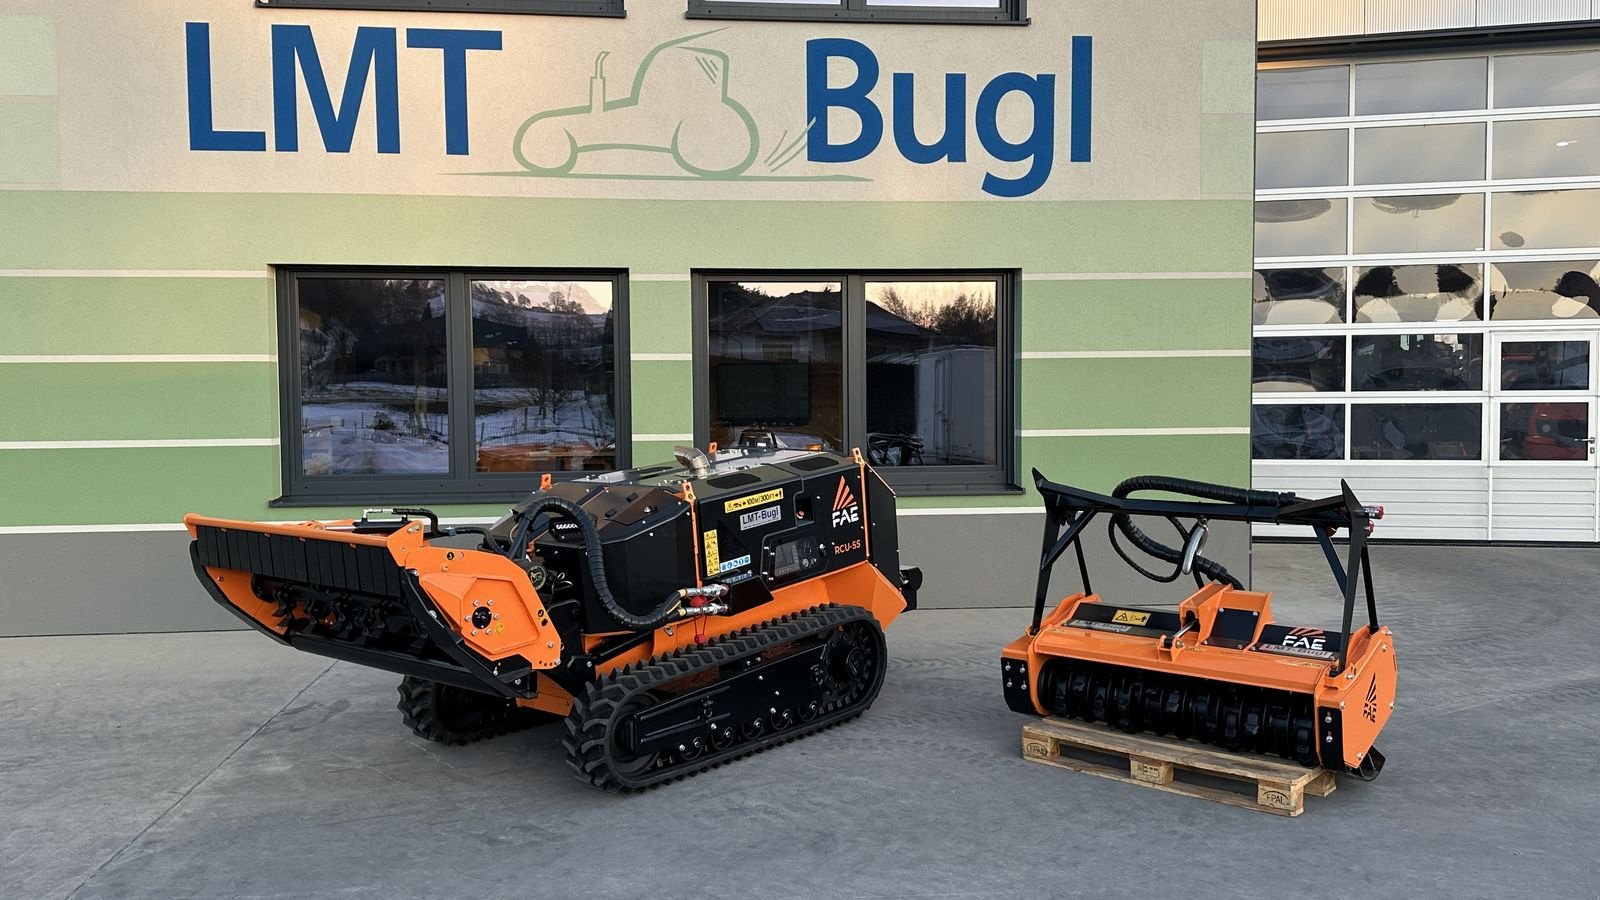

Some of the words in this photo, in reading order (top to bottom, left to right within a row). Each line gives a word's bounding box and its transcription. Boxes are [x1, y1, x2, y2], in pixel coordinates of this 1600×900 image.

[187, 23, 502, 155] LMT
[806, 36, 1092, 197] Bugl
[742, 507, 779, 525] LMT-Bugl
[831, 505, 860, 528] FAE
[834, 540, 861, 555] RCU-55
[1282, 635, 1326, 650] FAE
